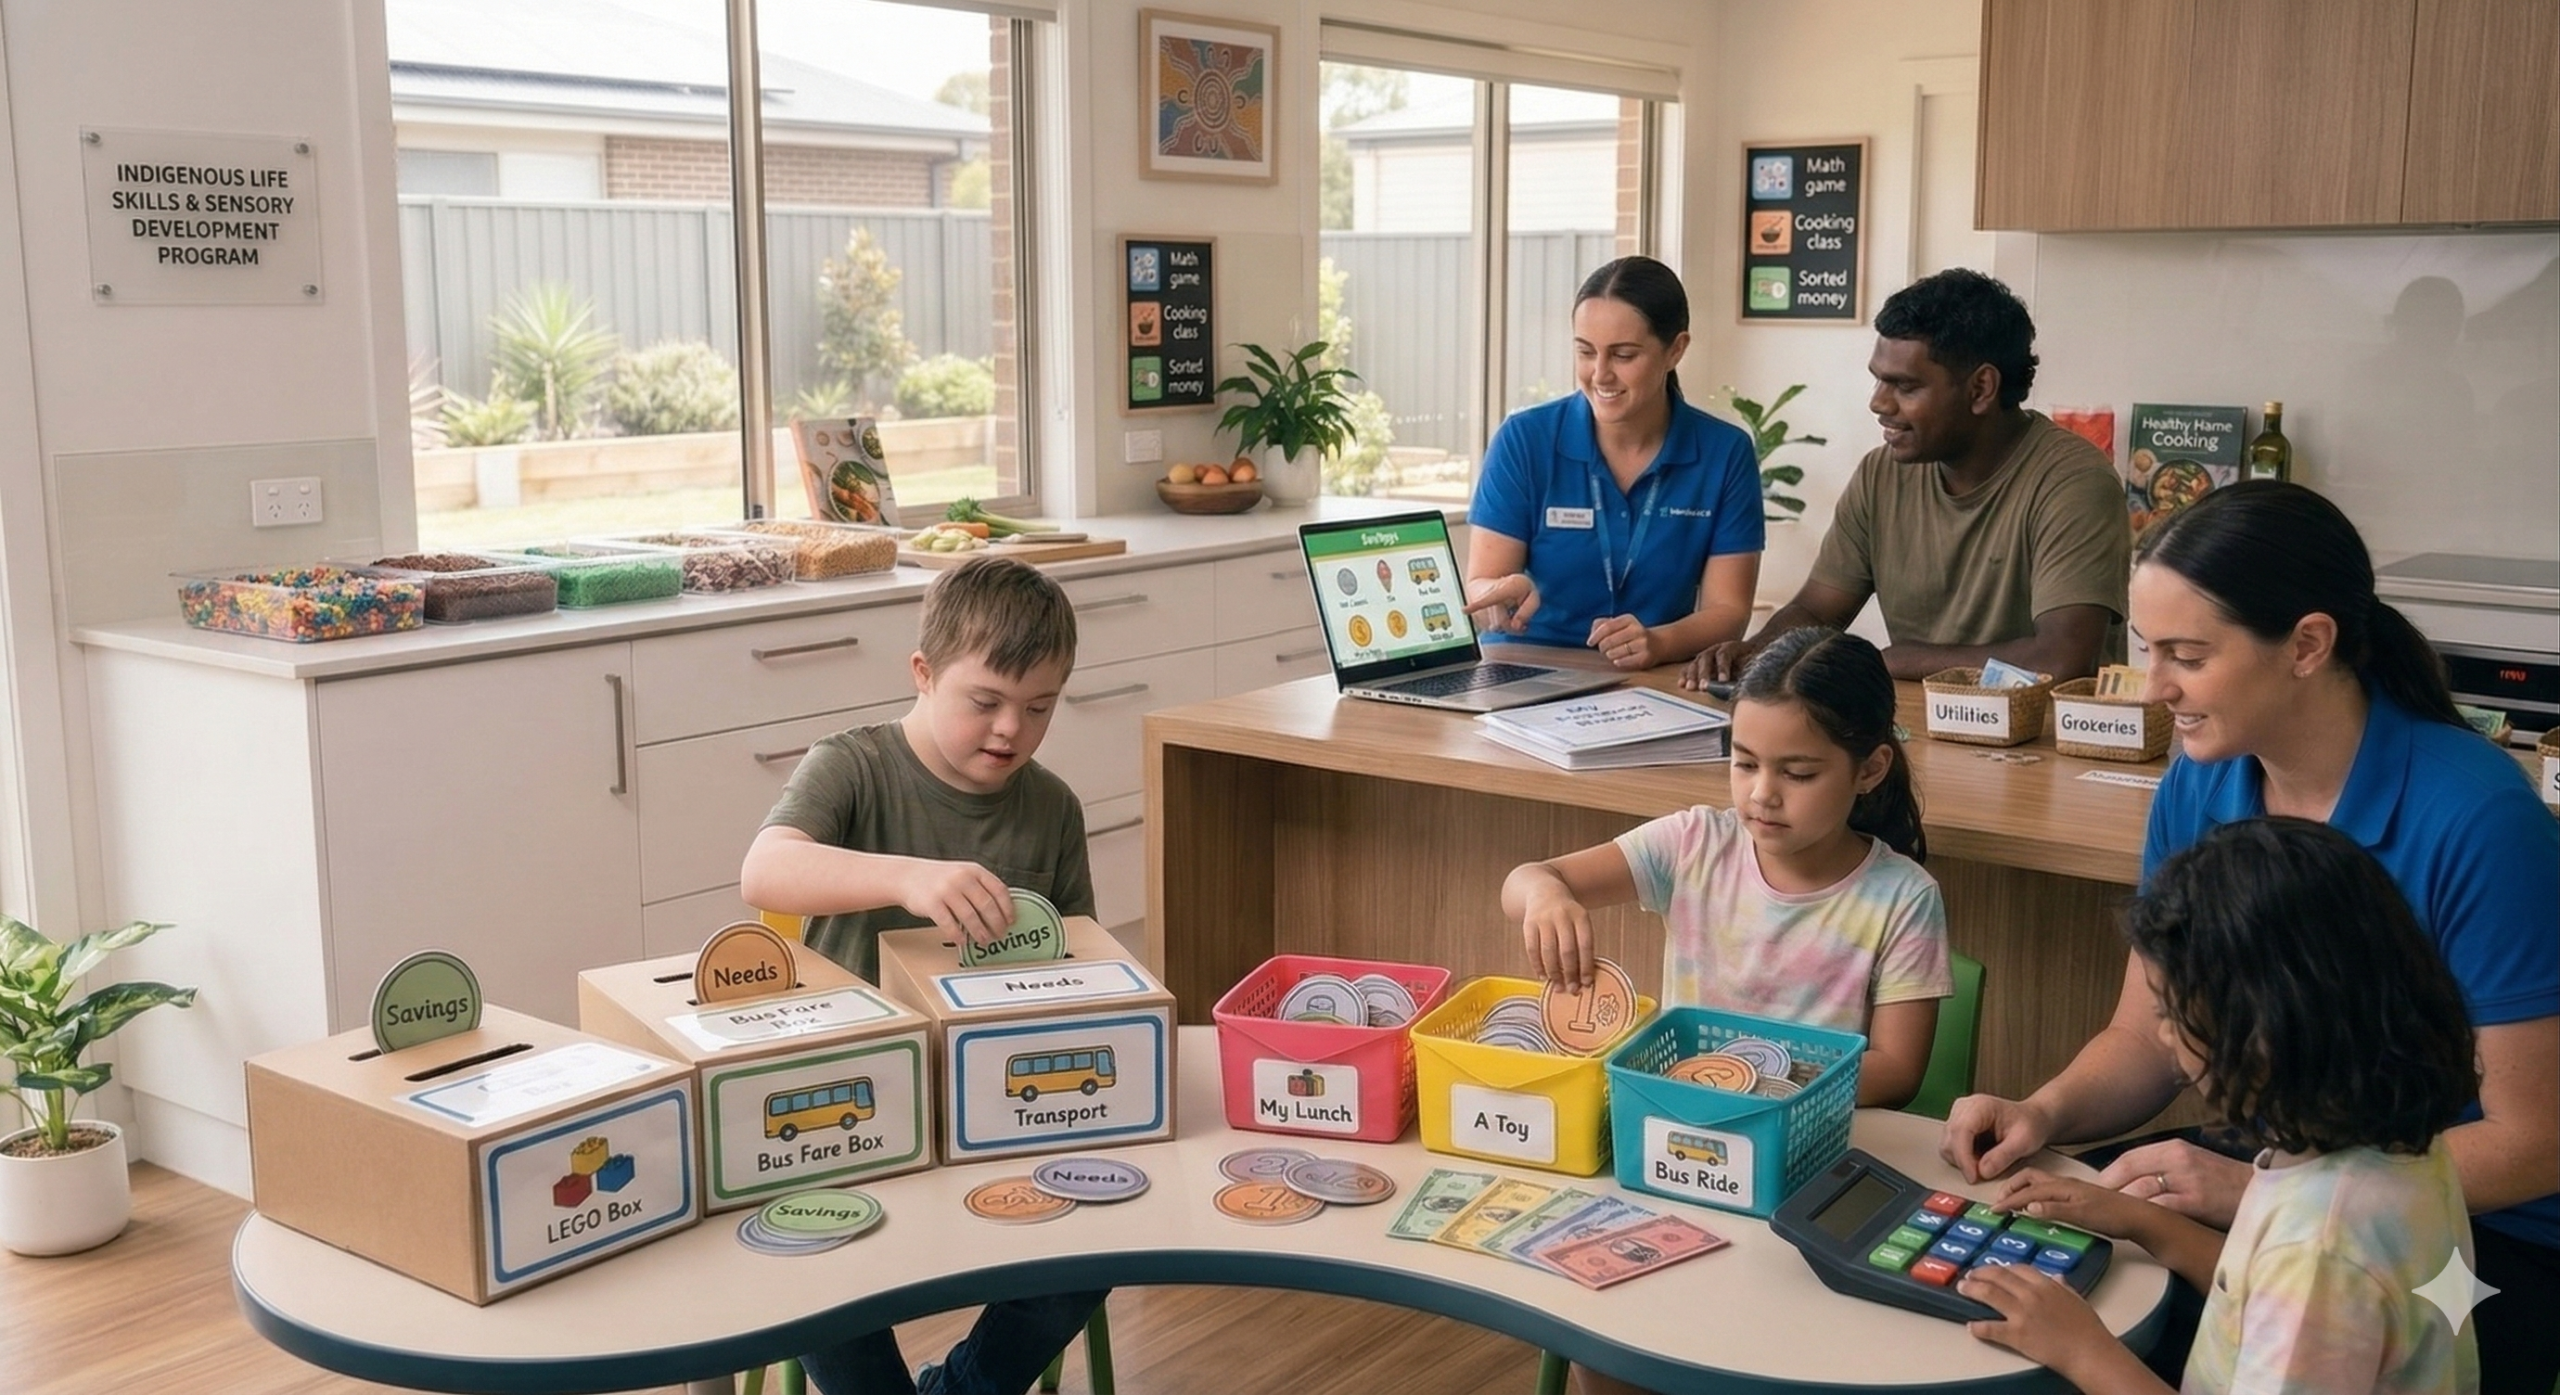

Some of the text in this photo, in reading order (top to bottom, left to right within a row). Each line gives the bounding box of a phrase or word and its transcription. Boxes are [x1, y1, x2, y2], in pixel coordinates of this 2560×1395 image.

[1806, 156, 1846, 173] Math
[117, 164, 289, 188] INDIGENOUS LIFE
[1805, 179, 1847, 197] game
[112, 191, 294, 214] SKILLS & SENSORY
[132, 218, 280, 240] DEVELOPMENT
[1795, 213, 1855, 234] Cooking
[1806, 233, 1842, 250] class
[158, 246, 259, 265] PROGRAM
[1170, 251, 1200, 267] Math
[1169, 273, 1200, 290] game
[1798, 270, 1847, 287] Sorted
[1797, 292, 1847, 310] money
[1164, 304, 1207, 325] Cooking
[1168, 357, 1204, 375] Sorted
[1168, 380, 1205, 397] money
[2152, 431, 2219, 452] Cooking
[974, 926, 1051, 959] Savings
[714, 961, 779, 989] Needs
[1005, 977, 1085, 993] Needs
[386, 996, 469, 1027] Savings
[728, 1001, 834, 1026] Bus Fare
[1014, 1103, 1108, 1128] Transport
[1260, 1098, 1353, 1123] My Lunch
[1474, 1112, 1529, 1143] A Toy
[757, 1134, 884, 1173] Bus Fare Box
[1053, 1170, 1129, 1183] Needs
[1655, 1161, 1740, 1195] Bus Ride
[547, 1198, 643, 1244] LEGO Box
[776, 1204, 861, 1221] Savings
[2001, 1237, 2027, 1250] 3
